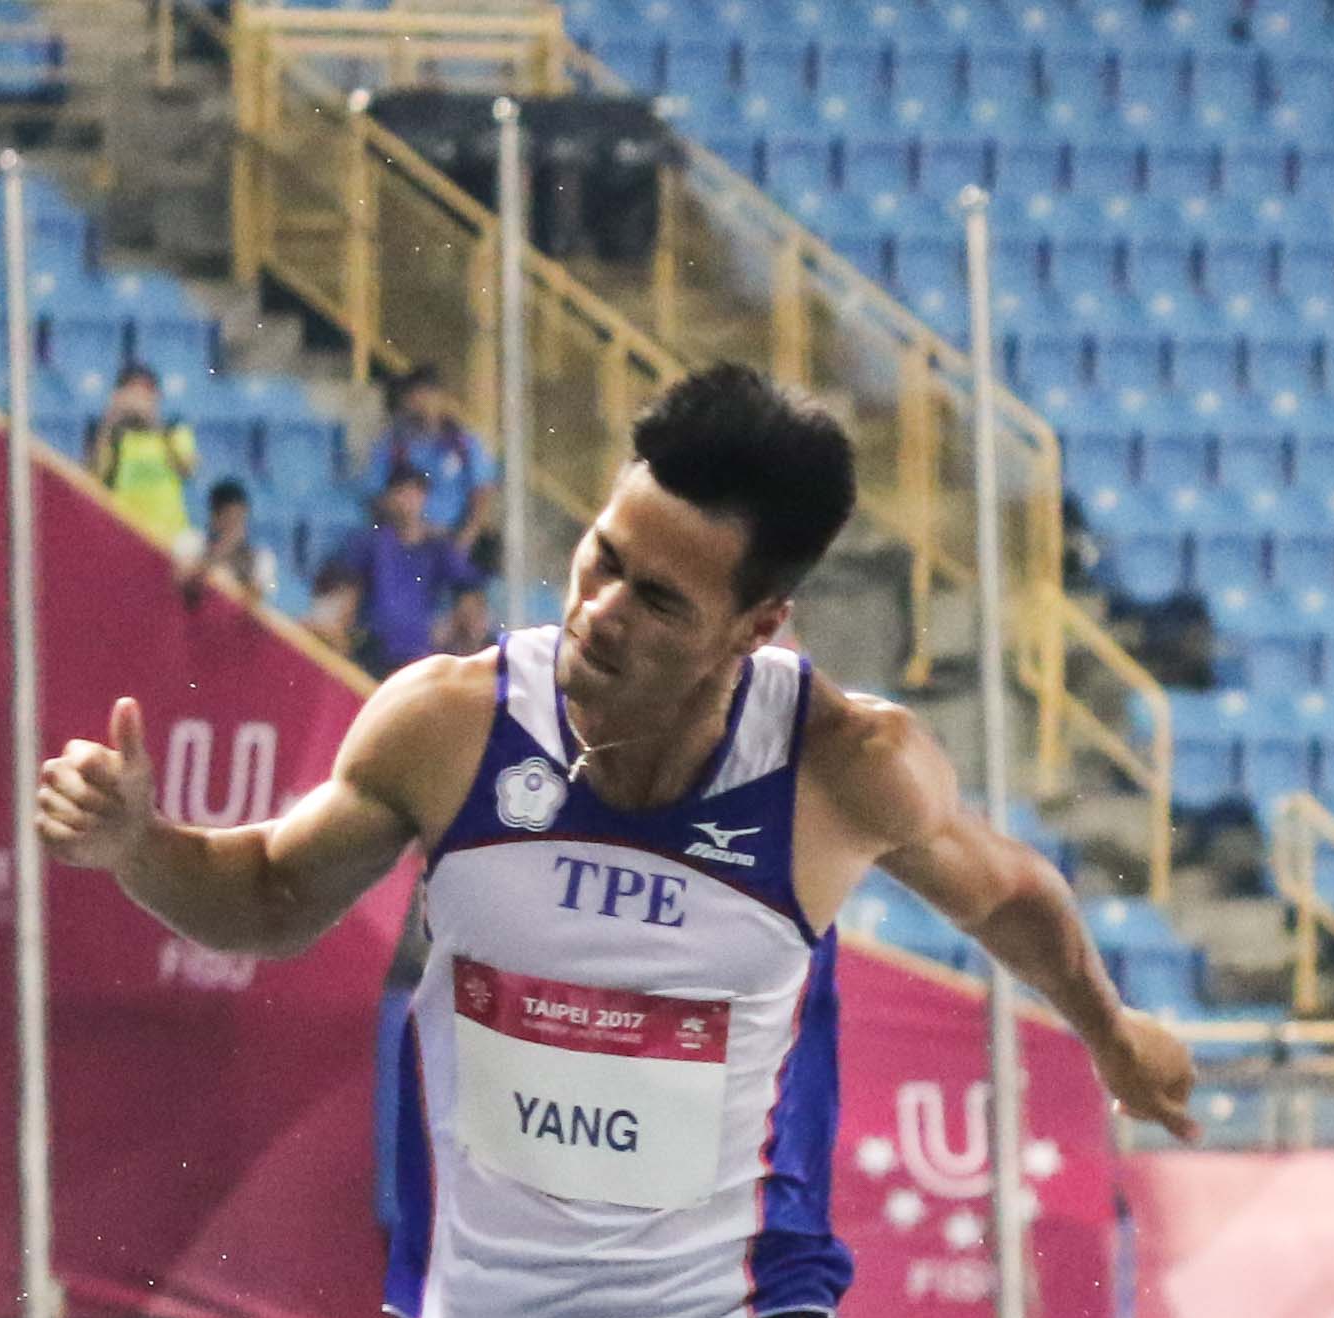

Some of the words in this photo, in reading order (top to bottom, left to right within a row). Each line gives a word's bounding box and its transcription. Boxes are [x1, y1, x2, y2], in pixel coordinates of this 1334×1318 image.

[555, 855, 687, 928] TPE
[521, 996, 588, 1026] TAIPEI
[594, 1009, 647, 1030] 2017
[513, 1090, 639, 1153] YANG
